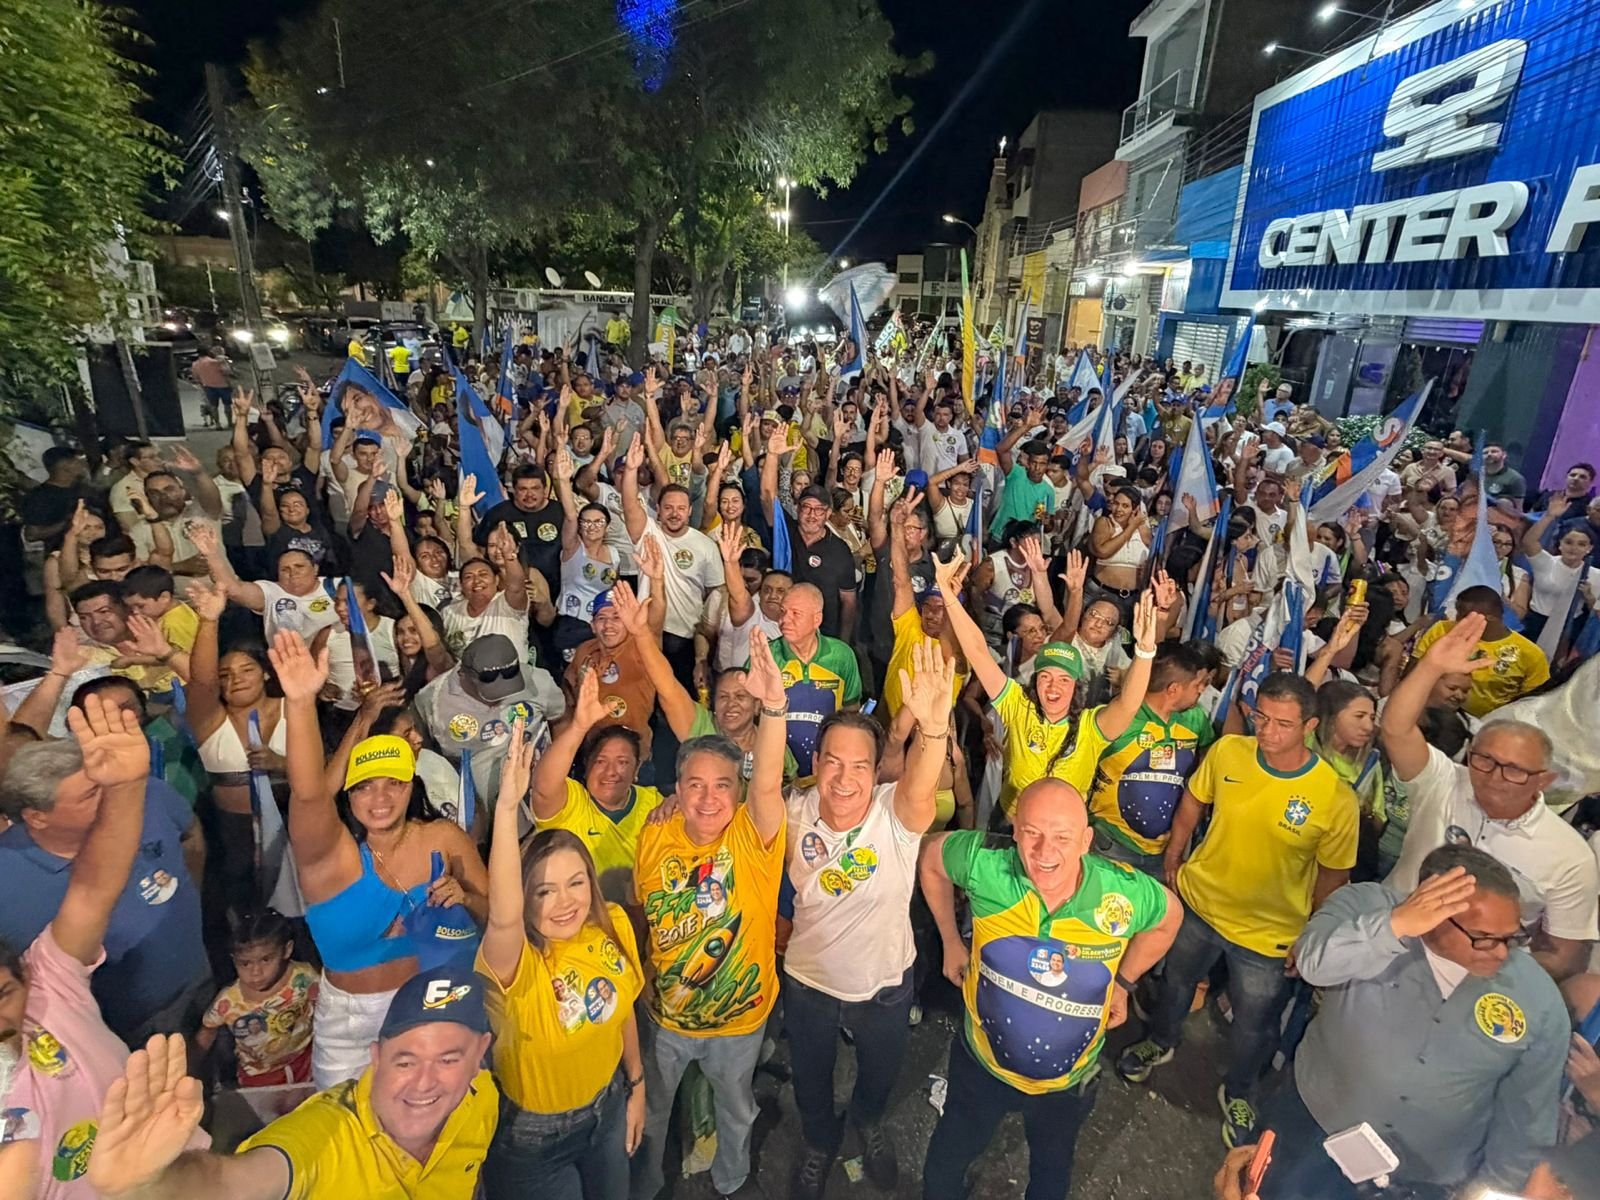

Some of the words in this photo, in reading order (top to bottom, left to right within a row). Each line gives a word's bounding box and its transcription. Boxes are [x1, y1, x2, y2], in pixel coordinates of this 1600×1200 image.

[1258, 180, 1529, 269] CENTER
[583, 295, 615, 303] BANCA
[656, 912, 699, 947] BOTE
[423, 979, 452, 1010] E
[713, 962, 762, 1018] 22
[980, 961, 1014, 991] ORDEM
[1021, 986, 1029, 998] E
[1511, 1018, 1524, 1038] 22
